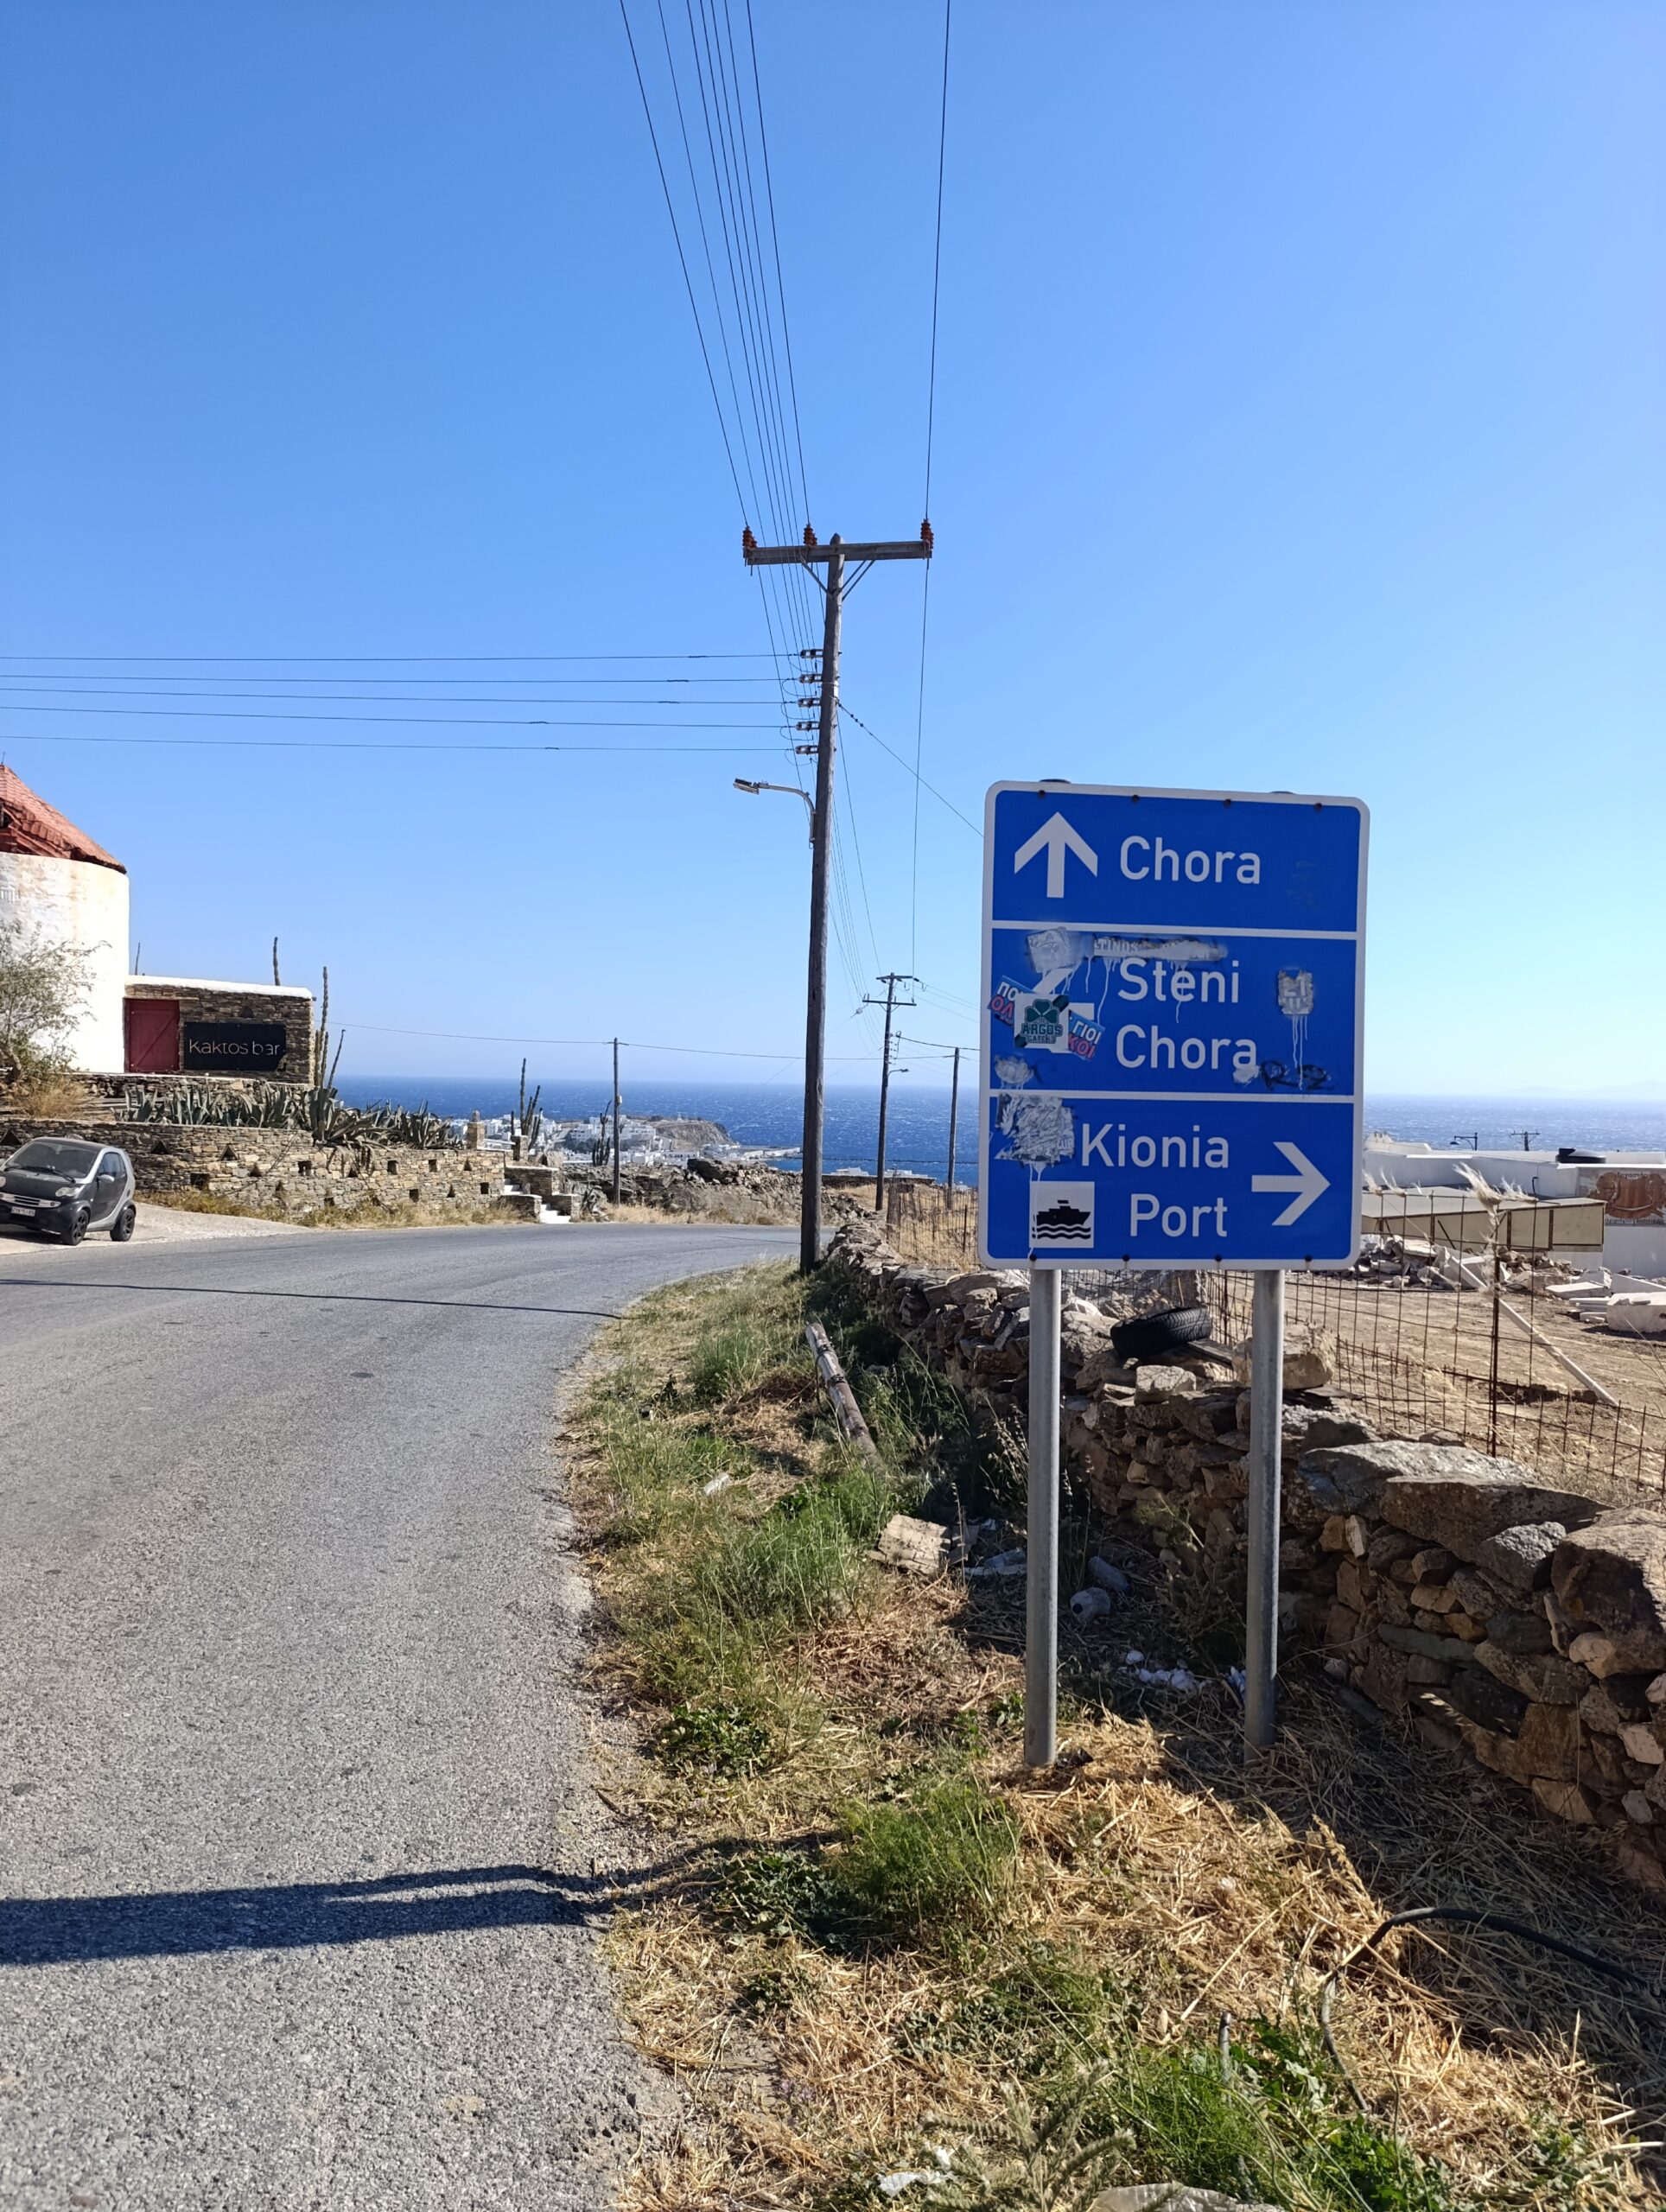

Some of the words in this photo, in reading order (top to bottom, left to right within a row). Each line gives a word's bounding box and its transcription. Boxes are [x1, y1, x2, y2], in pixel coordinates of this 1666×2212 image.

[1120, 836, 1261, 884] Chora
[1118, 957, 1240, 1003] Steni
[189, 1039, 249, 1054] Kaktos
[252, 1040, 280, 1055] bar
[1021, 1024, 1062, 1035] ARGOS
[1116, 1024, 1258, 1071] Chora
[1082, 1123, 1230, 1168] Kionia
[1130, 1192, 1229, 1237] Port
